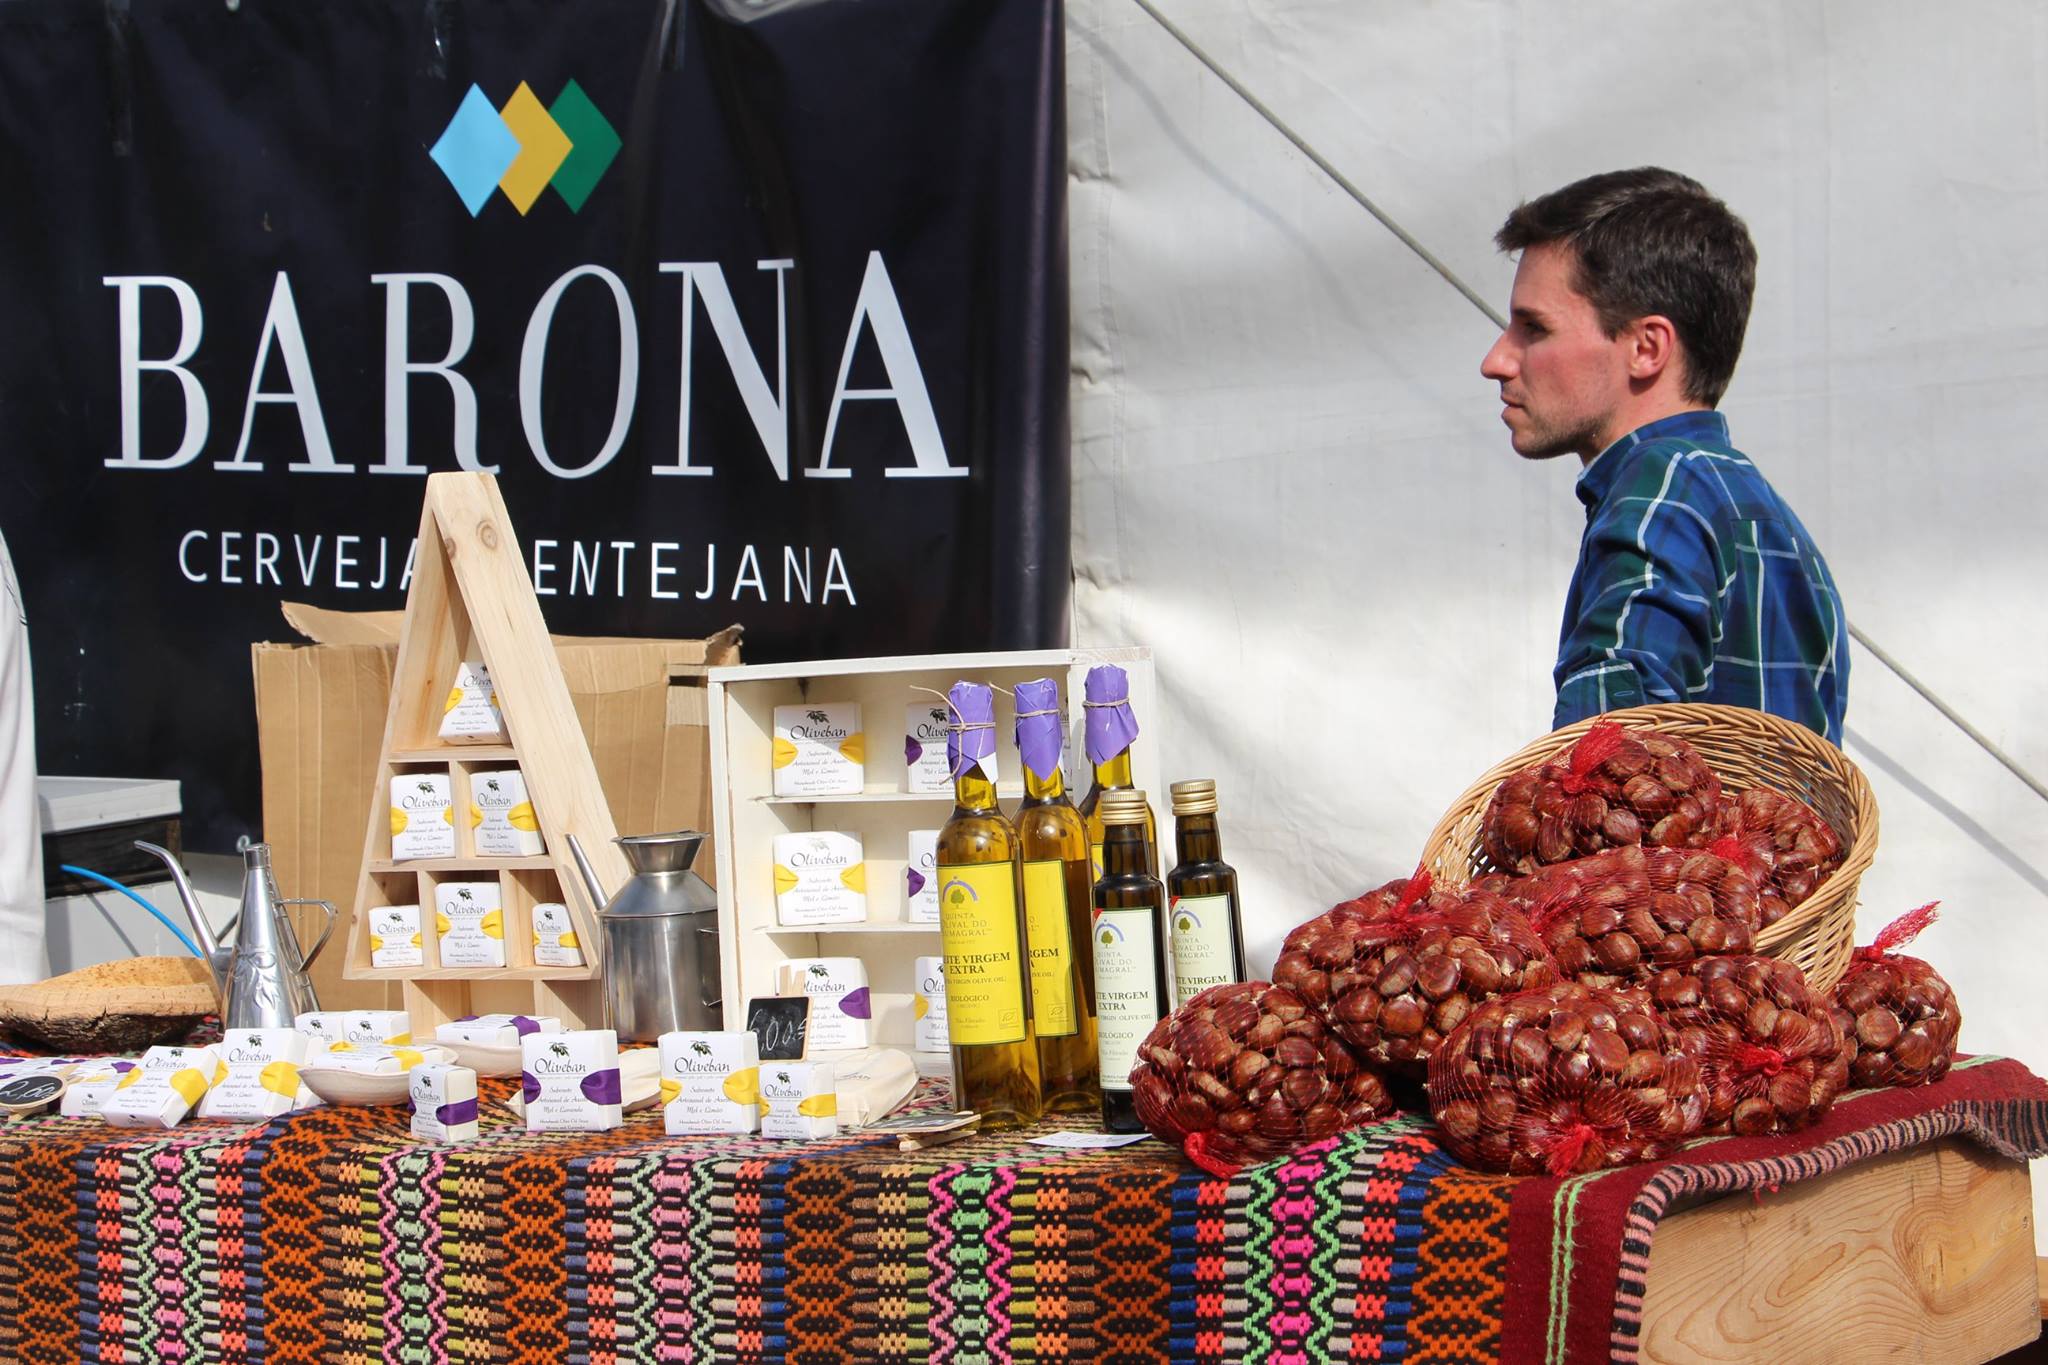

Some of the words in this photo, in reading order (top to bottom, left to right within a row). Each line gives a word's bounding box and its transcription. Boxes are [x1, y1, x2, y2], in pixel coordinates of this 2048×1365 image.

[102, 249, 971, 482] BARONA
[534, 538, 857, 607] ENTEJANA
[790, 725, 848, 740] Oliveban
[402, 795, 452, 809] Oliveban
[790, 852, 848, 867] Oliveban
[963, 951, 1010, 964] VIRGEM
[950, 964, 985, 975] EXTRA
[804, 979, 846, 993] liveban
[1188, 974, 1227, 985] VIRGEM
[1108, 990, 1149, 1000] VIRGEM
[1098, 1002, 1127, 1011] EXTRA
[533, 1057, 586, 1074] Oliveban
[674, 1056, 731, 1074] Oliveban
[764, 1084, 802, 1098] Oliveban
